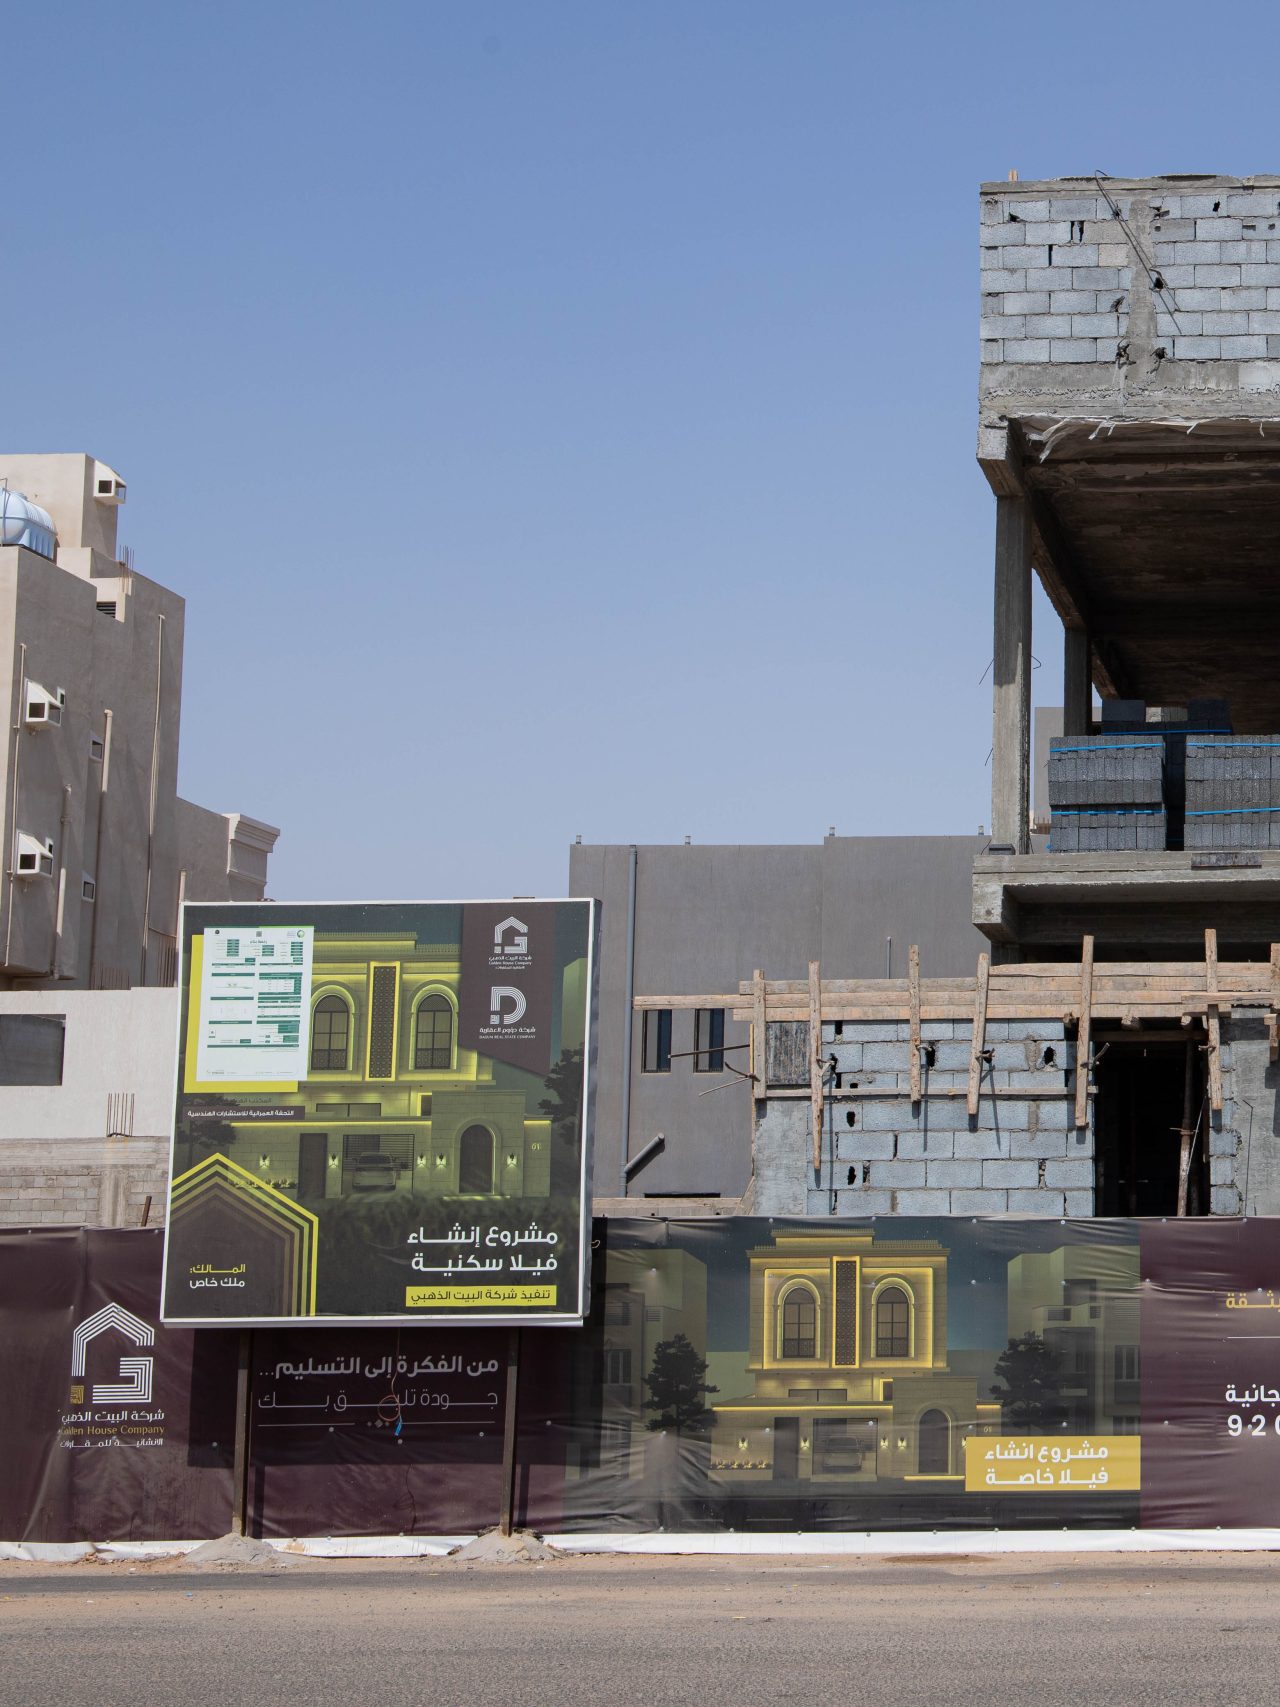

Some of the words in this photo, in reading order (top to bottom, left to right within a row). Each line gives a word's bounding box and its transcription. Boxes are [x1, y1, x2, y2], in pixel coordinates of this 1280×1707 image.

[518, 1026, 536, 1034] شركة
[249, 1110, 274, 1118] العمرانية
[407, 1222, 480, 1248] إنشاء
[486, 1222, 558, 1247] مشروع
[190, 1263, 246, 1274] المالك:
[411, 1252, 503, 1277] سكنية
[510, 1253, 558, 1276] فيلا
[190, 1277, 218, 1289] خاص
[220, 1277, 246, 1288] ملك
[411, 1291, 450, 1305] الذهبي
[453, 1290, 482, 1303] البيت
[485, 1289, 517, 1302] شركة
[520, 1289, 551, 1303] تنفيذ
[365, 1356, 392, 1378] إلى
[397, 1355, 462, 1377] الفكرة
[467, 1358, 499, 1376] من
[258, 1391, 330, 1412] بك
[333, 1389, 416, 1411] تليق
[420, 1388, 498, 1410] جودة
[61, 1411, 92, 1425] الذهبي
[95, 1411, 128, 1423] البيت
[131, 1409, 165, 1422] شركة
[87, 1425, 118, 1435] House
[120, 1425, 165, 1435] Company
[984, 1441, 1034, 1460] انشاء
[1038, 1440, 1109, 1463] مشروع
[985, 1467, 1054, 1485] خاصة
[1059, 1467, 1109, 1489] فيلا
